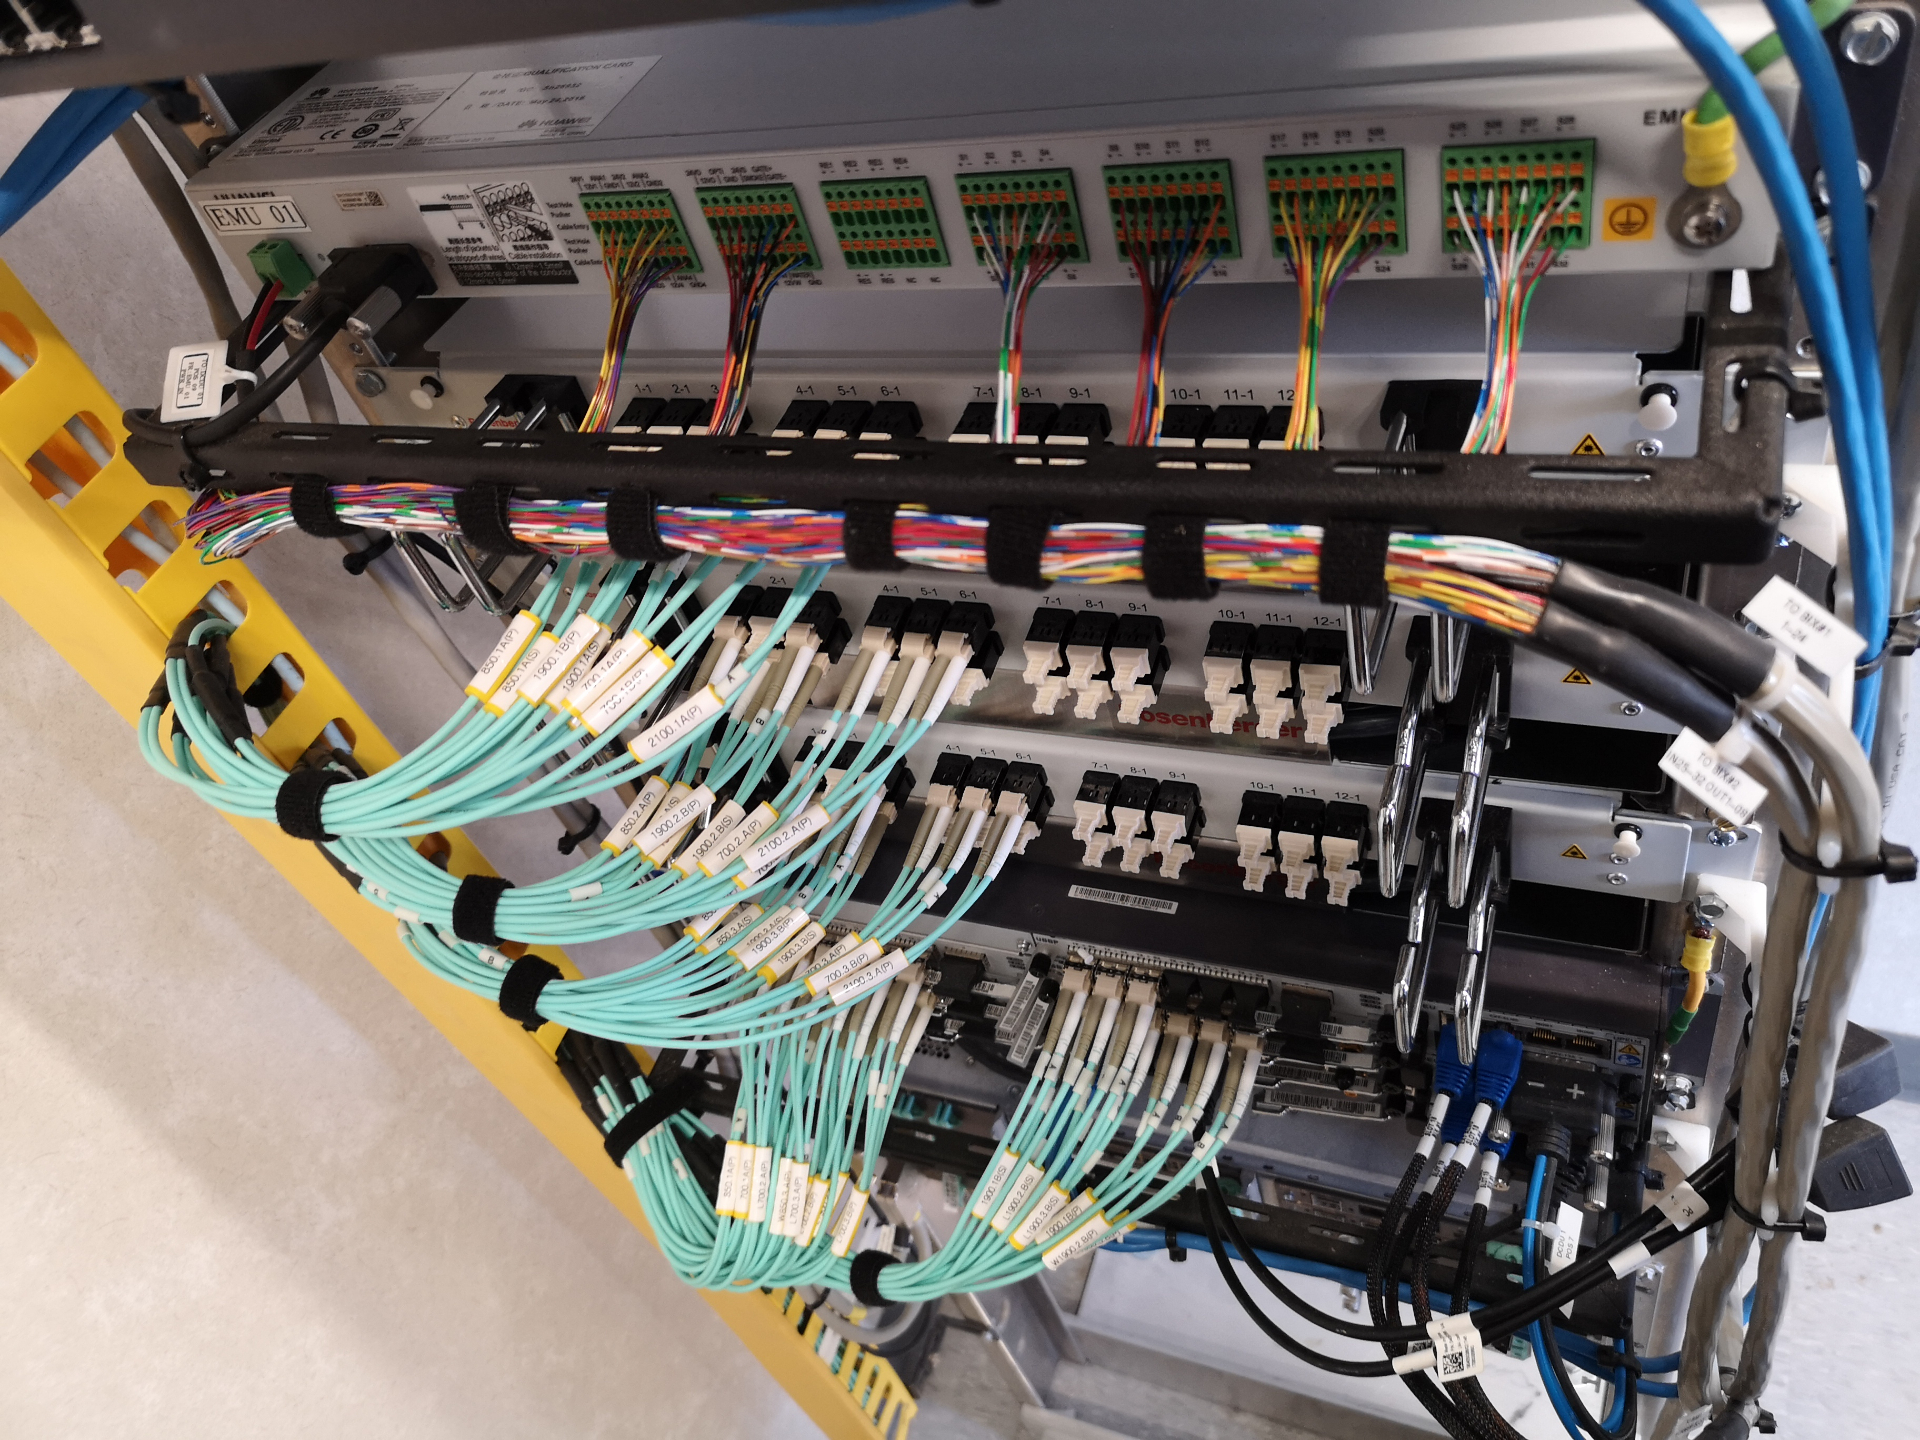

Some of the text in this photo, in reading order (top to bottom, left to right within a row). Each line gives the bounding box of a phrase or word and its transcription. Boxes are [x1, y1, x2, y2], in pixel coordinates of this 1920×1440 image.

[538, 116, 592, 126] HUAWEI
[210, 204, 298, 227] EMU 01
[634, 383, 652, 394] 1-1
[671, 383, 691, 394] 2-1
[795, 384, 815, 396] 4-1
[837, 384, 857, 396] 5-1
[880, 385, 900, 396] 6-1
[973, 386, 994, 397] 7-1
[1021, 386, 1041, 398] 8-1
[1069, 386, 1090, 398] 9-1
[1170, 388, 1201, 400] 10-1
[1223, 388, 1254, 400] 11-1
[769, 575, 786, 586] 2-1
[881, 583, 899, 594] 4-1
[920, 586, 937, 596] 5-1
[959, 588, 976, 599] 6-1
[1042, 595, 1061, 606] 7-1
[1085, 598, 1104, 609] 8-1
[1128, 601, 1147, 612] 9-1
[1217, 609, 1245, 619] 10-1
[1265, 612, 1292, 623] 11-1
[1312, 615, 1341, 627] 12-1
[481, 628, 518, 675] 850.1A(P)
[533, 629, 580, 681] 1900.1B(P)
[501, 648, 540, 693] 850.1A(S)
[562, 639, 600, 692] 1900.1A(S)
[647, 704, 702, 748] 2100.1A(P)
[945, 744, 960, 752] 4-1
[980, 748, 996, 757] 5-1
[1015, 752, 1031, 761] 6-1
[1091, 761, 1108, 770] 7-1
[1129, 765, 1146, 775] 8-1
[1168, 770, 1185, 779] 9-1
[1249, 781, 1274, 790] 10-1
[1291, 786, 1315, 796] 11-1
[1334, 791, 1359, 801] 12-1
[619, 791, 655, 835] 850.2.A(P)
[650, 797, 701, 839] 1900.2.B(P)
[691, 814, 734, 861] 1900.2.B(S)
[716, 818, 762, 860] 700.2.A(P)
[757, 815, 813, 858] 2100.2.A(P)
[751, 917, 793, 954] 1900.3.B(P)
[777, 931, 816, 964] 1900.3.B(S)
[824, 952, 868, 983] 700.3.B(P)
[981, 1164, 1006, 1206] 1900.1B(S)
[1002, 1174, 1035, 1221] L1900.2.B(S)
[1023, 1195, 1060, 1240] L1900.3.B(S)
[1556, 1235, 1565, 1257] DCDU
[1565, 1242, 1573, 1259] POS
